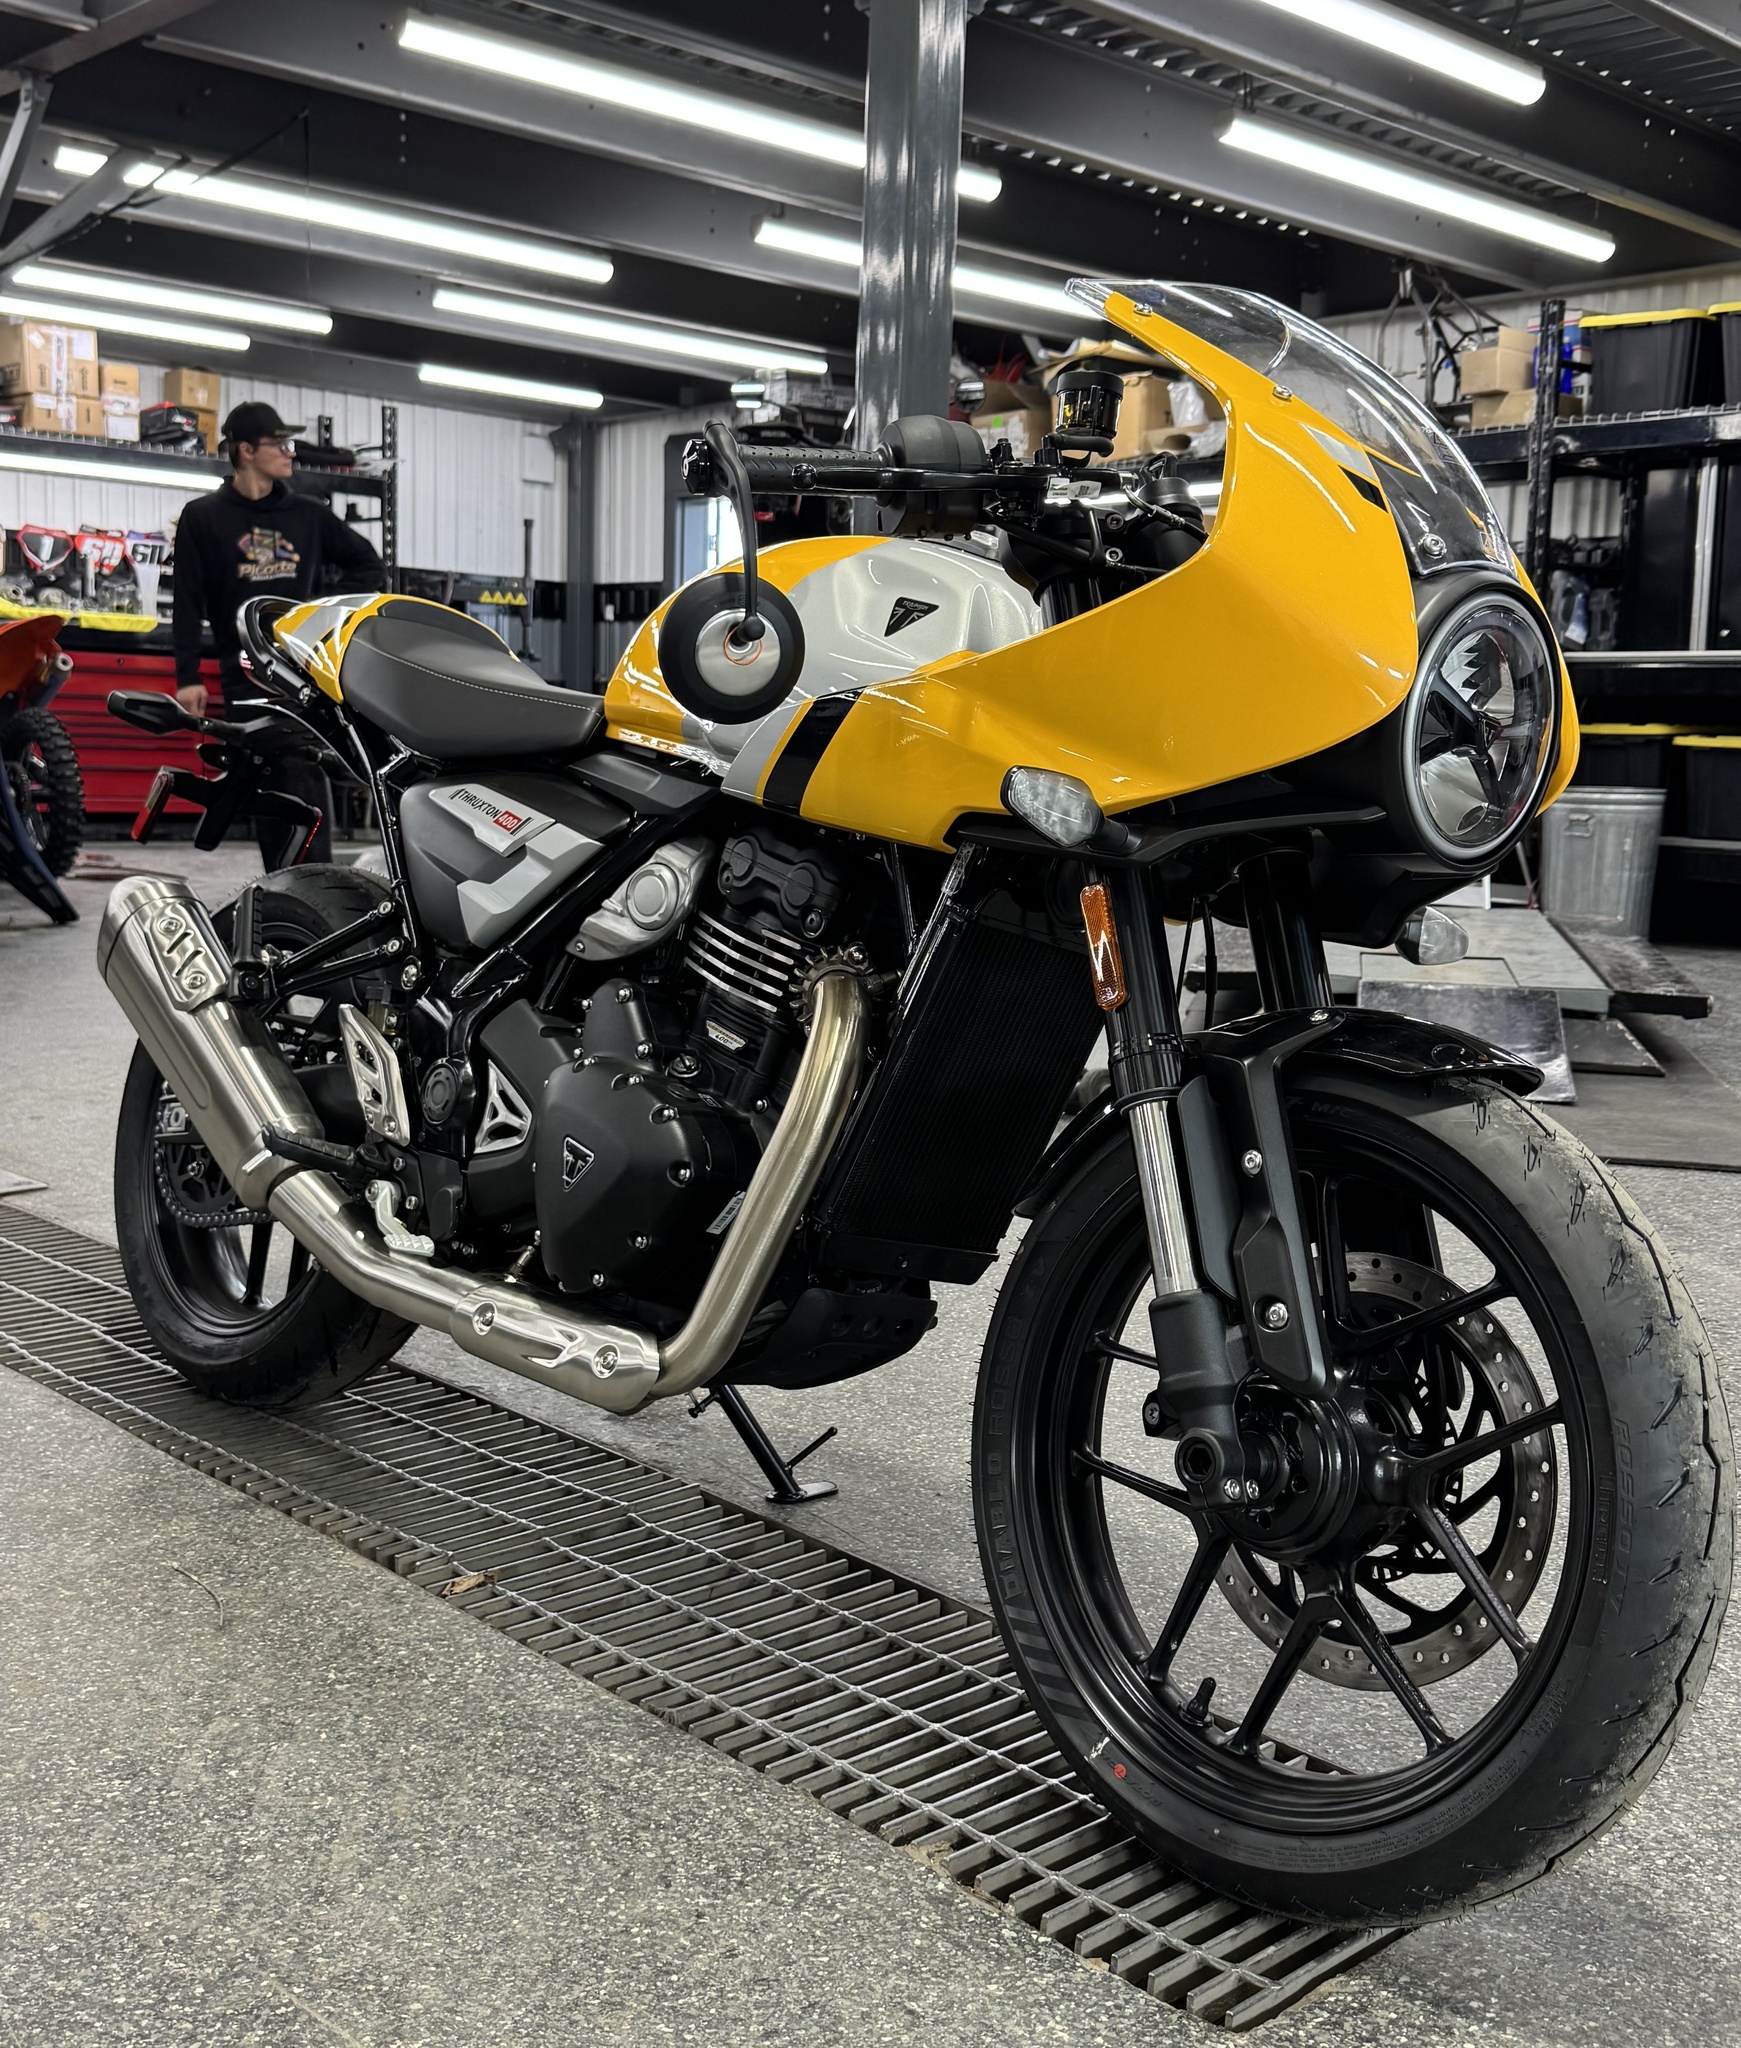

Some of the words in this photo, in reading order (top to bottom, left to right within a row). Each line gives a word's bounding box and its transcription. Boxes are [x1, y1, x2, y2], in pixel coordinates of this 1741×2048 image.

[457, 791, 502, 819] THRUXTON
[497, 813, 519, 830] 400
[987, 1315, 1023, 1436] ROSSO
[987, 1450, 1024, 1598] DIABLO
[1612, 1417, 1634, 1555] ROSSO
